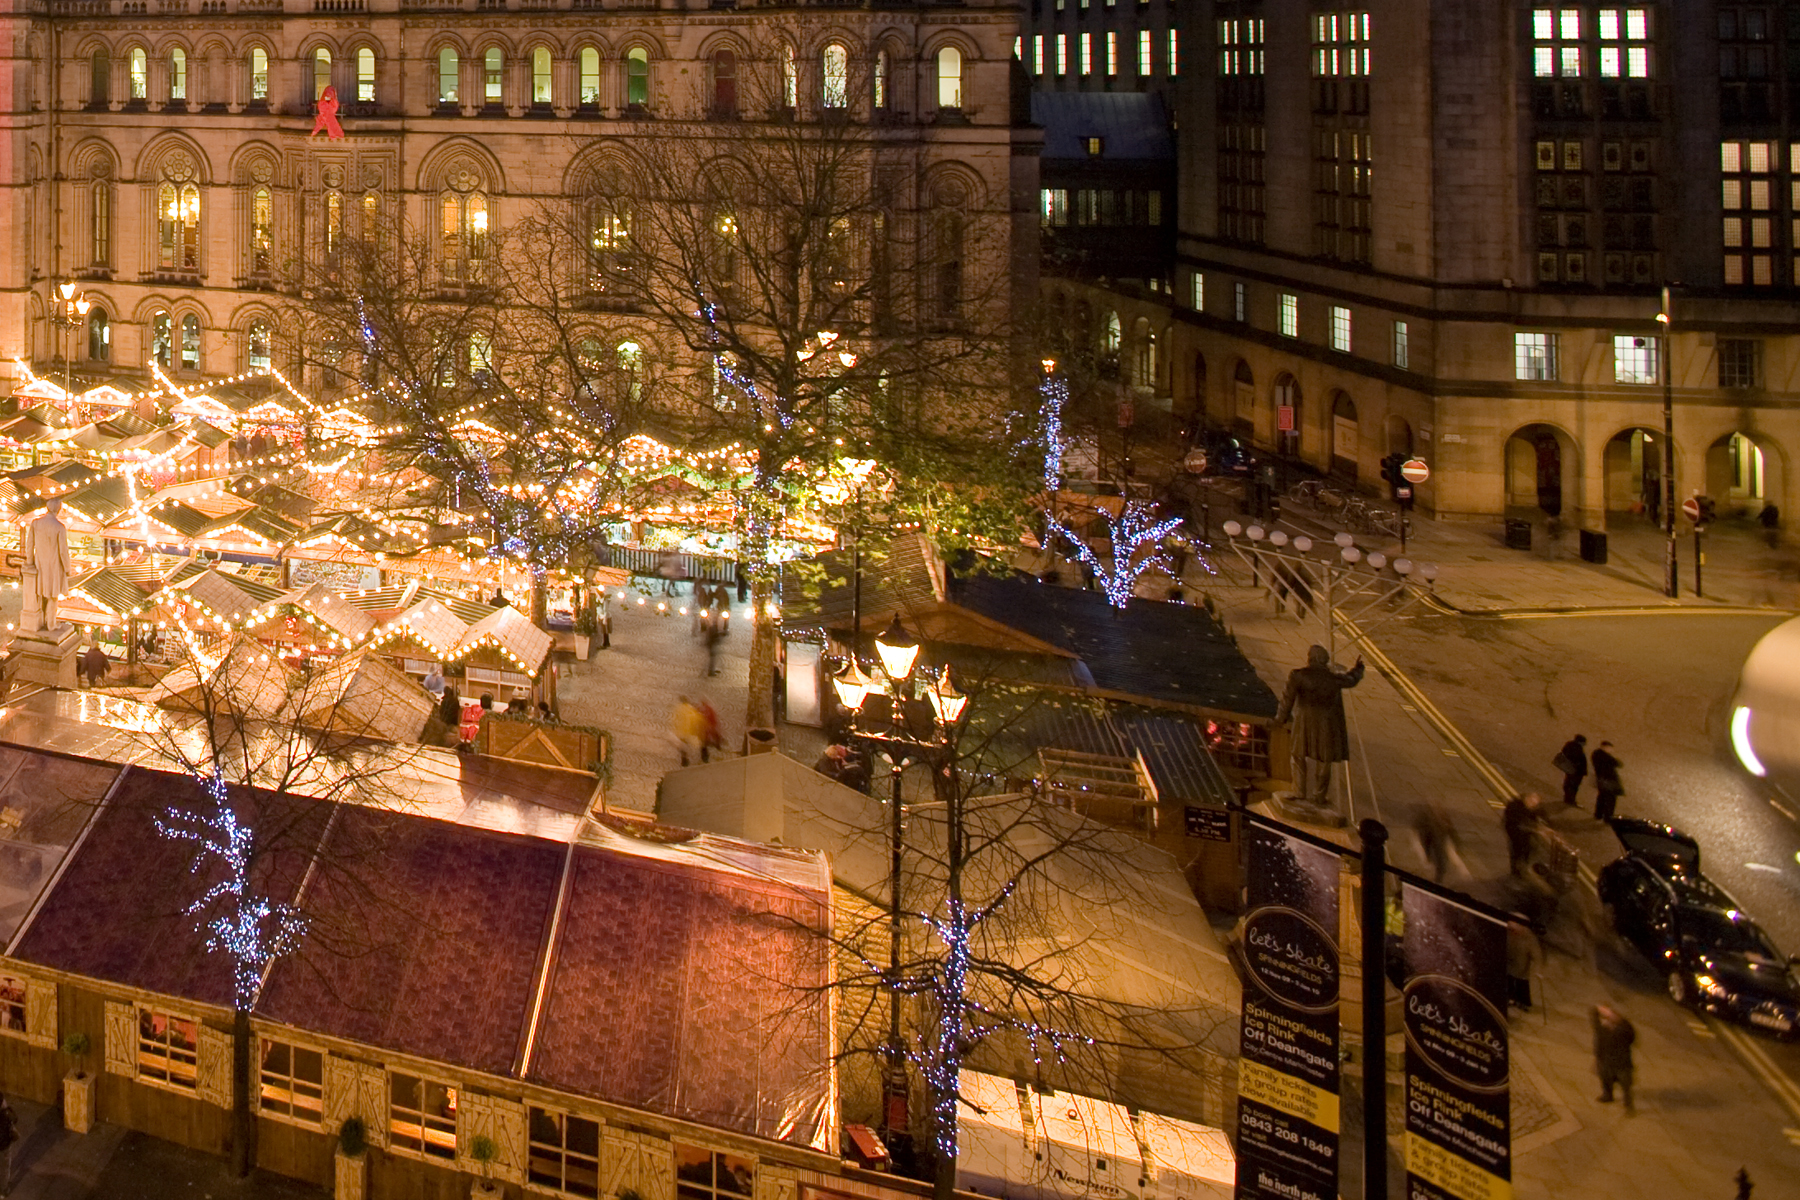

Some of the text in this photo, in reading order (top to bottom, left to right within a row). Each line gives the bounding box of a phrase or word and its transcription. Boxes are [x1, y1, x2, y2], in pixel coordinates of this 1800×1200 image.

[1249, 926, 1333, 974] let's skate
[1245, 1002, 1333, 1046] Spinningfields
[1245, 1015, 1295, 1042] Ice Rink
[1409, 994, 1504, 1051] let's skate
[1243, 1041, 1326, 1079] City Centre Manchester
[1244, 1026, 1334, 1070] Off Deansgate
[1243, 1062, 1317, 1098] Family tickets
[1243, 1073, 1319, 1110] & group rates
[1242, 1086, 1316, 1120] now available
[1409, 1074, 1505, 1130] Spinningfields
[1410, 1087, 1464, 1122] Ice Rink
[1241, 1113, 1273, 1134] 0843
[1274, 1127, 1299, 1144] 208
[1409, 1100, 1508, 1157] Off Deansgate
[1411, 1136, 1489, 1184] Family tickets
[1411, 1161, 1435, 1178] now
[1451, 1136, 1499, 1166] Manchester
[1257, 1171, 1274, 1187] the
[1274, 1177, 1300, 1199] north
[1411, 1148, 1490, 1198] & group rates
